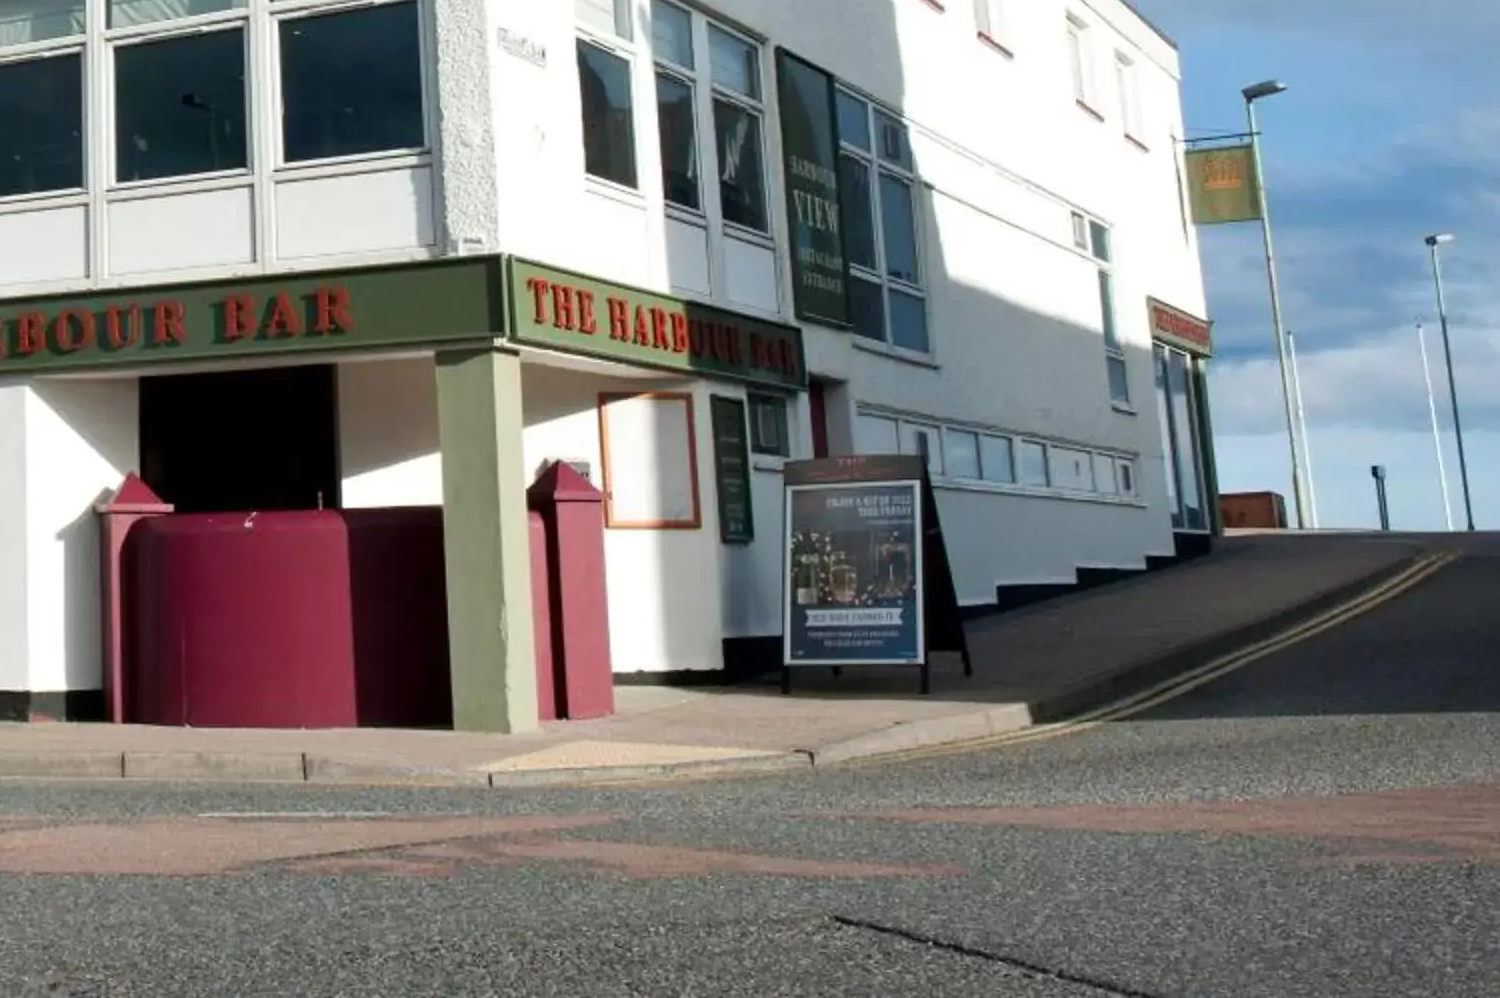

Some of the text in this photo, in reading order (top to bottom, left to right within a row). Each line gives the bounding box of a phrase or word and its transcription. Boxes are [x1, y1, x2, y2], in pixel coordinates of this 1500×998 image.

[792, 188, 840, 234] VIEW
[218, 283, 355, 343] BAR
[526, 277, 797, 377] THE HARBOUR BAR
